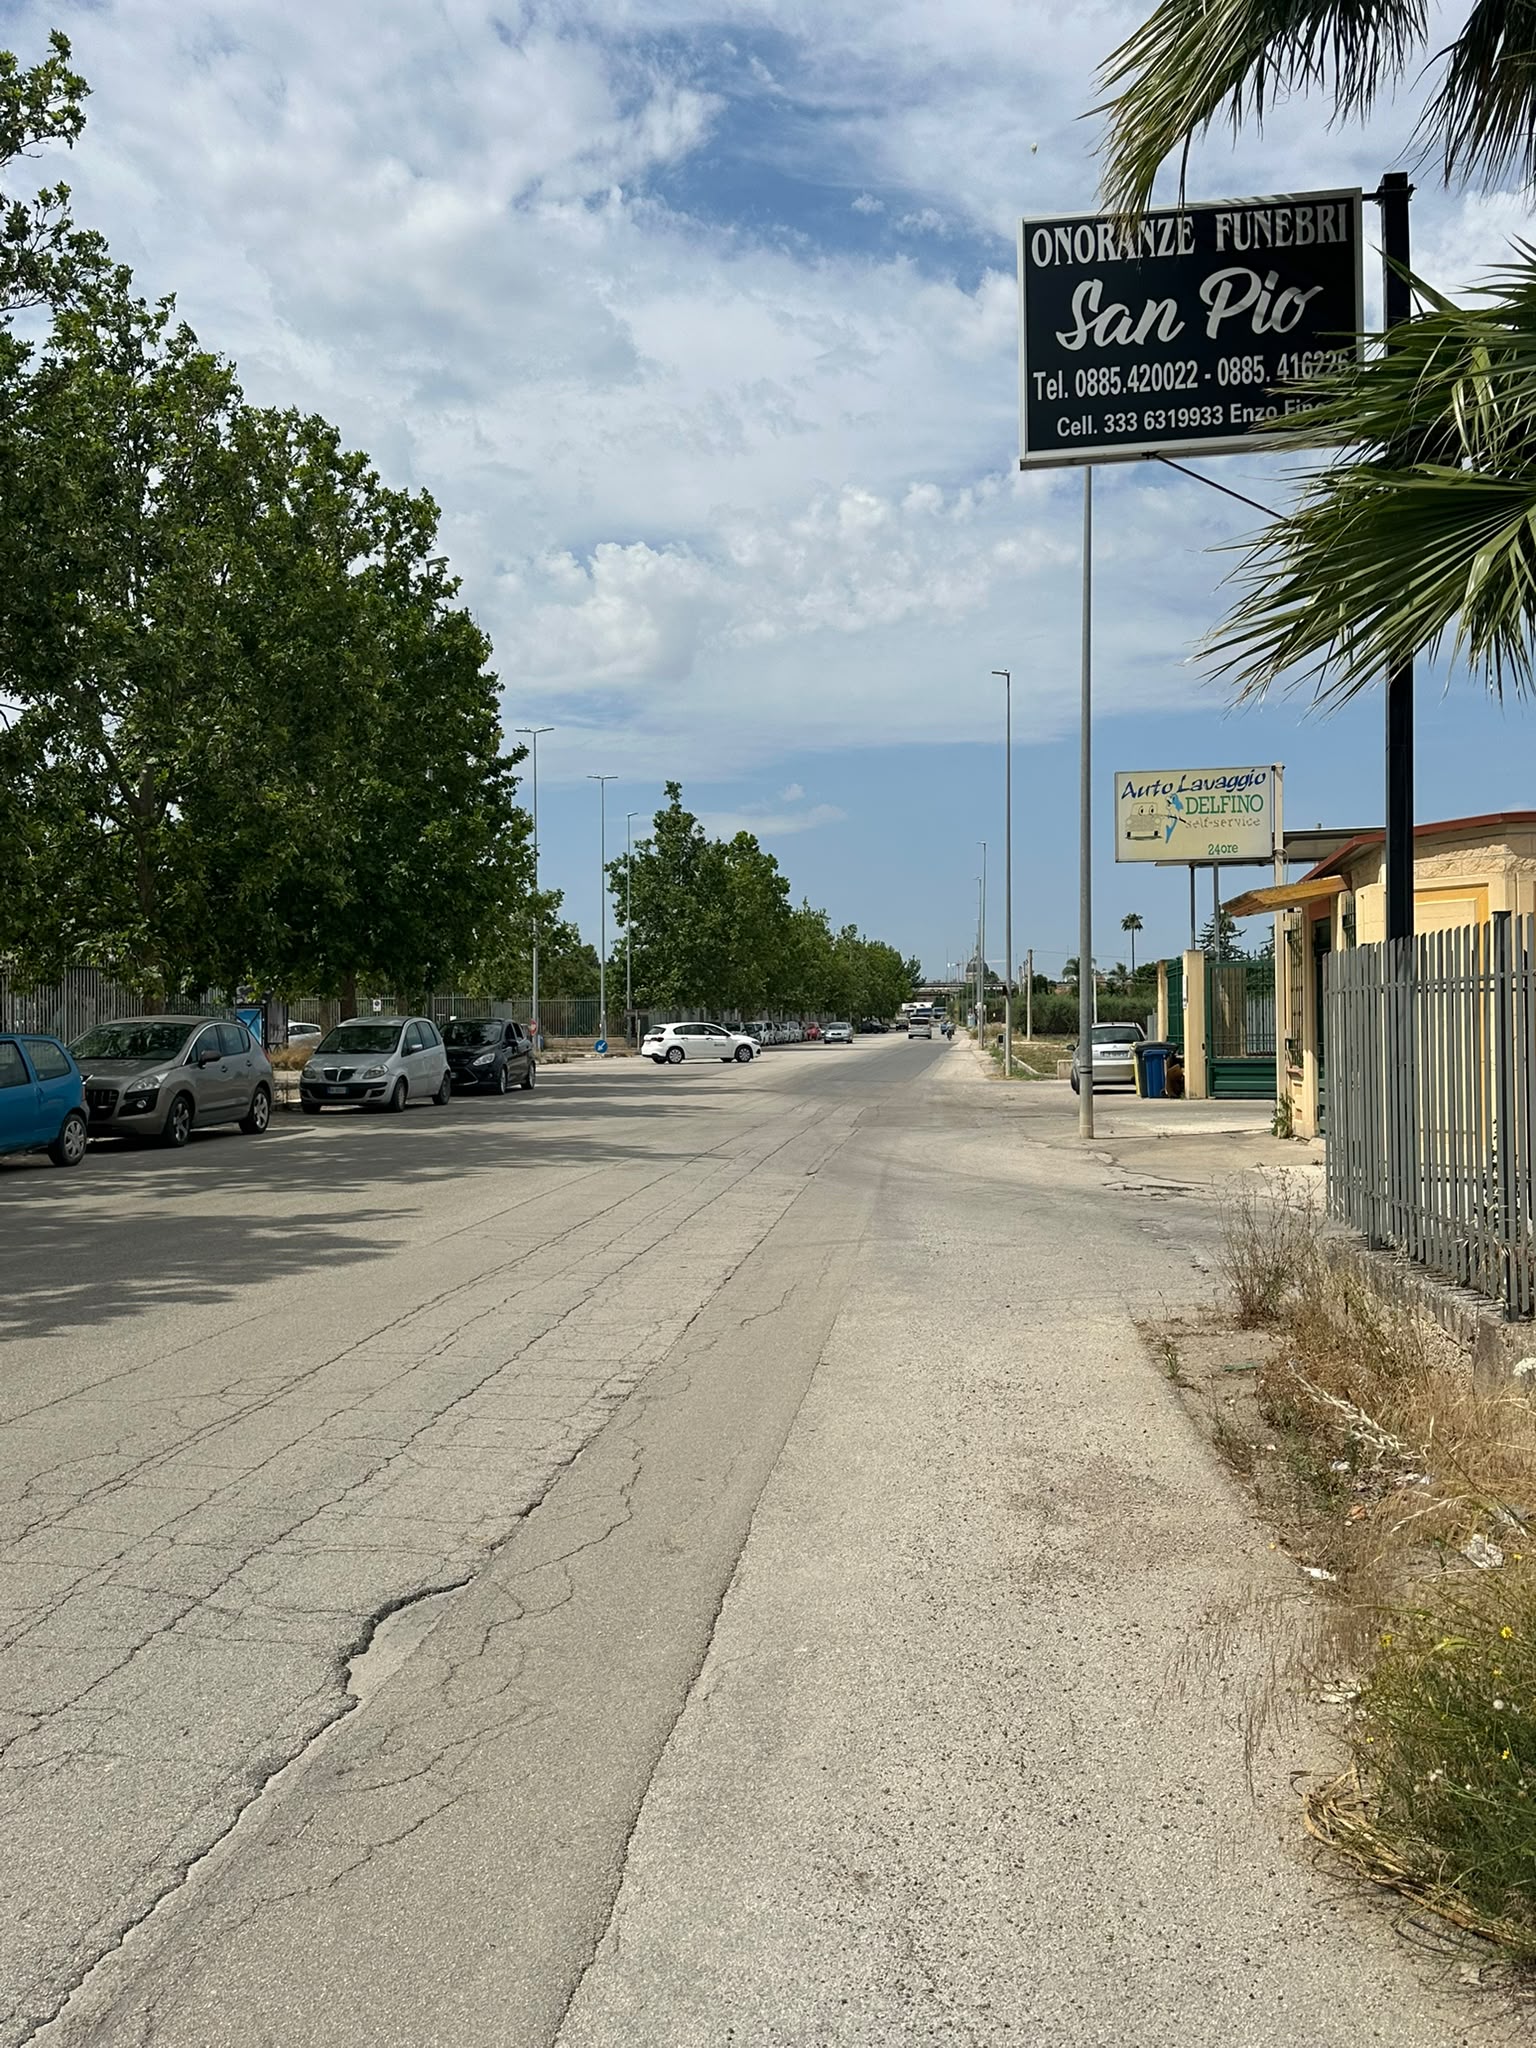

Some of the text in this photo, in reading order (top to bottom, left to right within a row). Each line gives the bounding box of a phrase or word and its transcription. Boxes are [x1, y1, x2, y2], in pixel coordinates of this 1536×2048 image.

[1031, 203, 1348, 268] ONORANZE FUNEBRI
[1055, 267, 1324, 350] San Pio
[1033, 370, 1068, 400] Tel.
[1075, 360, 1198, 397] 0885.420022
[1217, 355, 1270, 387] 0885.
[1057, 414, 1097, 437] Cell.
[1103, 412, 1138, 433] 333
[1144, 405, 1223, 430] 6319933
[1230, 403, 1277, 424] Enzo
[1121, 768, 1266, 800] Auto Lavaggio
[1185, 794, 1264, 815] DELFINO
[1185, 815, 1261, 829] self-service
